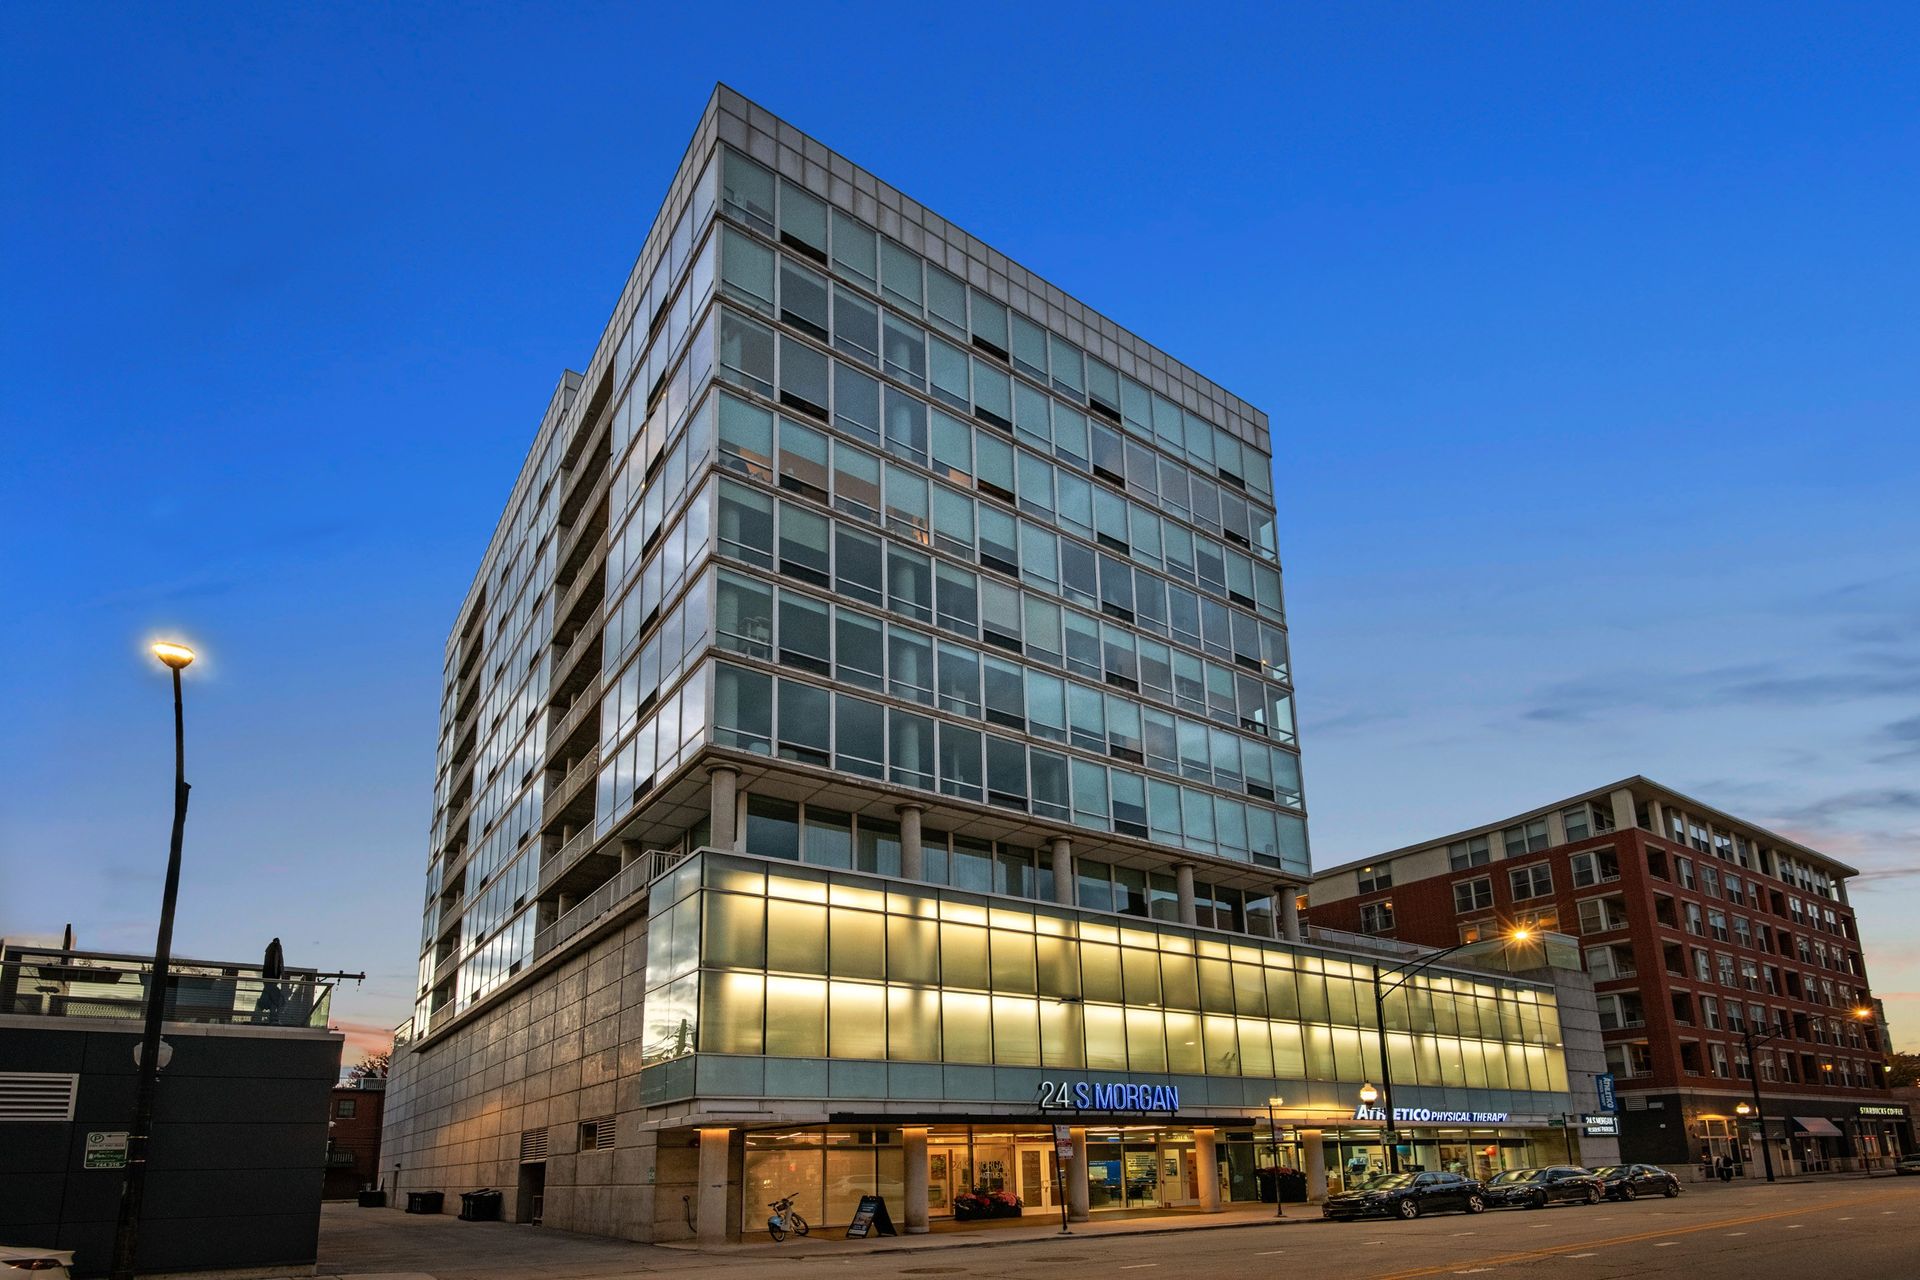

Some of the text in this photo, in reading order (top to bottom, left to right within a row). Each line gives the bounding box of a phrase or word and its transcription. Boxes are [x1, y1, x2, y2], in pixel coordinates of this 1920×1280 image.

[1041, 1081, 1179, 1110] 24 S MORGAN
[1357, 1104, 1508, 1123] ATHETICO PHYSICAL THERAPY
